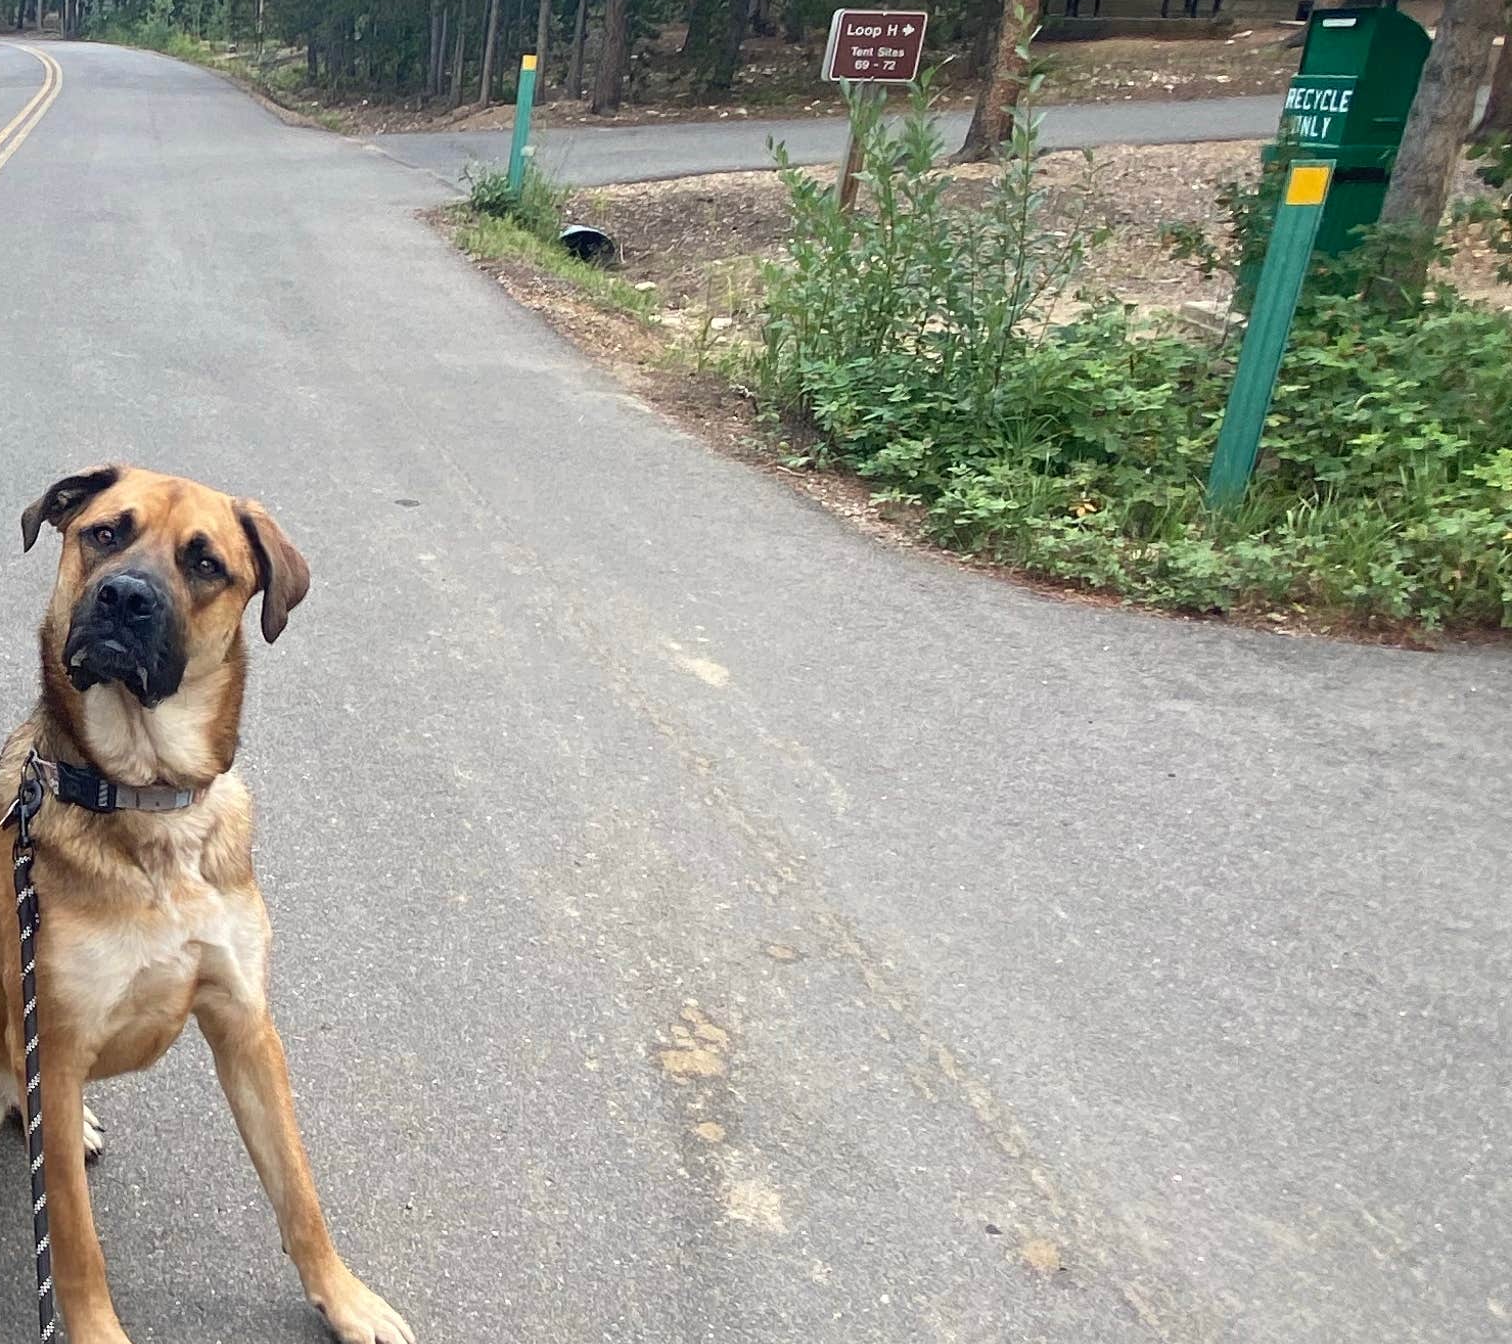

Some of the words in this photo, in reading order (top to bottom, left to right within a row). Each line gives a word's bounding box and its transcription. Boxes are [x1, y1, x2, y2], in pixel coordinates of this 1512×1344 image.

[847, 24, 882, 38] Loop
[887, 24, 899, 36] H
[851, 46, 874, 56] Tent
[877, 47, 905, 58] Sites
[854, 60, 869, 70] 69
[883, 60, 897, 71] 72
[1285, 87, 1354, 113] RECYCLE
